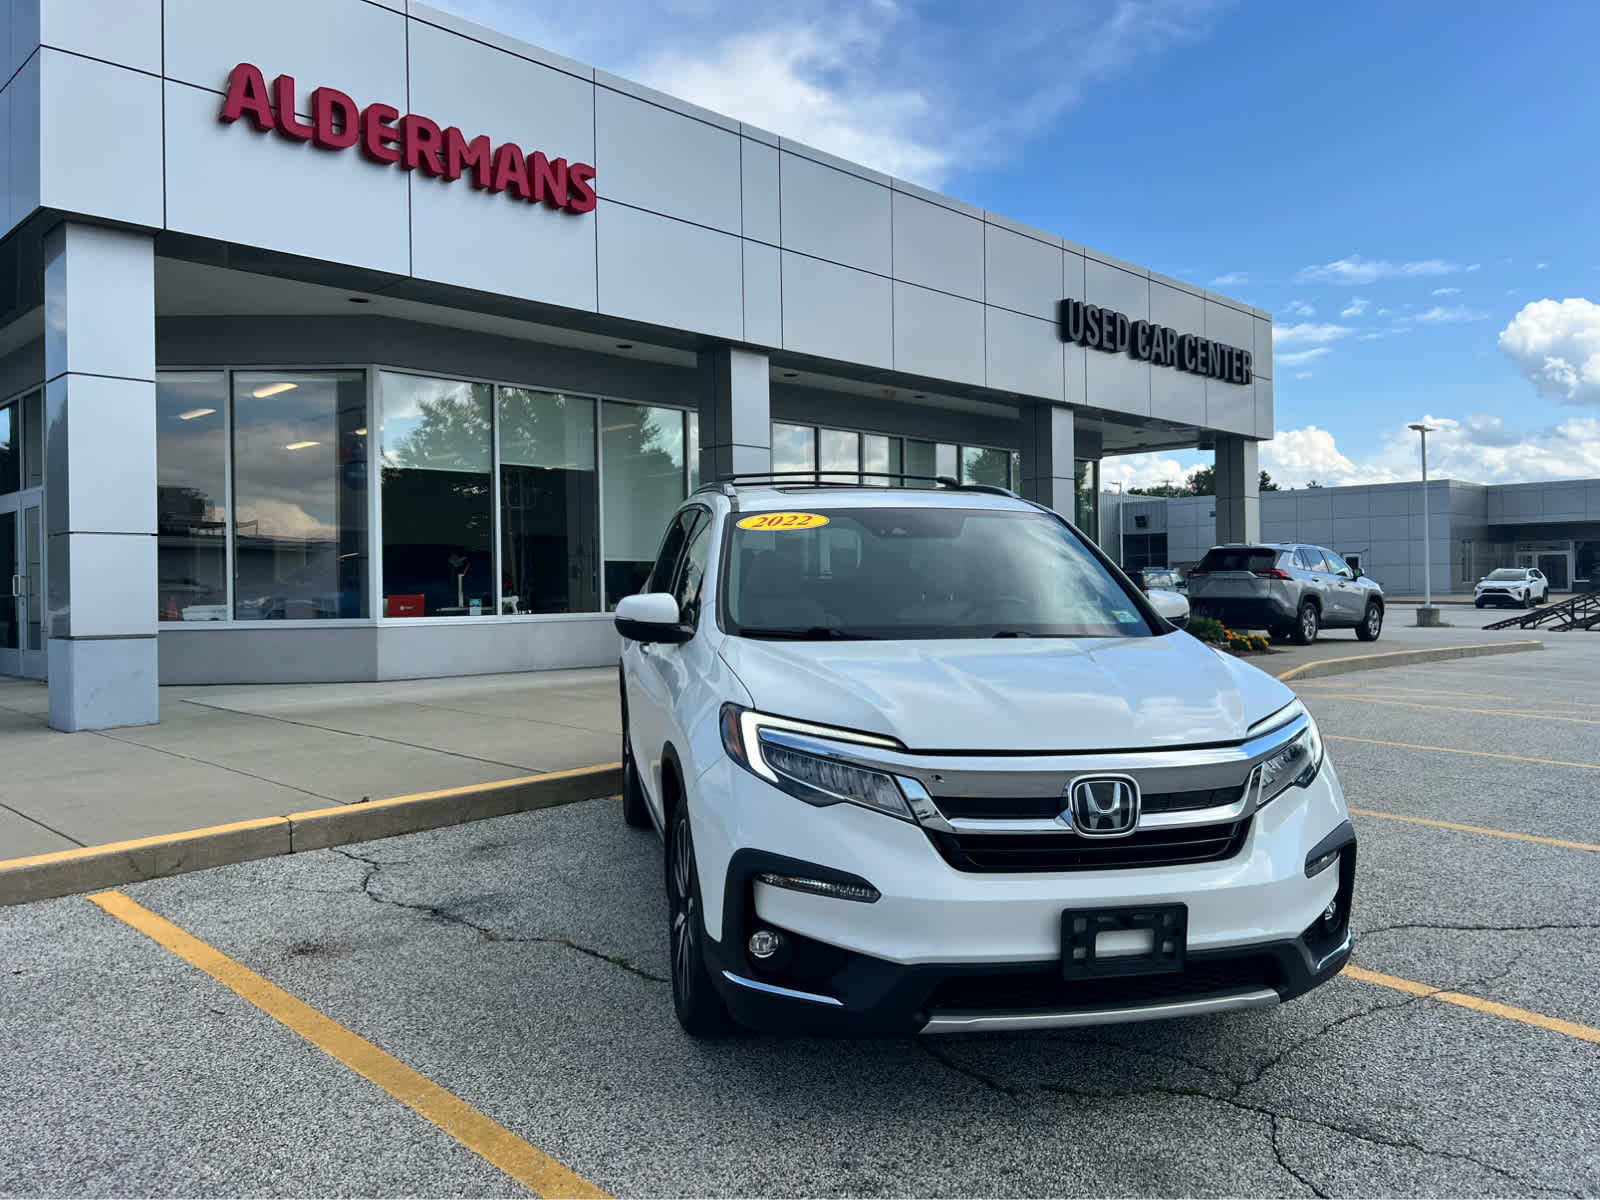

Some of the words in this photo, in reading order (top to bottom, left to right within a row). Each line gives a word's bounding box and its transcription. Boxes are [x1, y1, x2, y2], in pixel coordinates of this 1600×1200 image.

[219, 63, 597, 215] ALDERMANS
[1061, 298, 1130, 352] USED
[1131, 319, 1178, 366] CAR
[1179, 333, 1253, 384] CENTER
[751, 515, 813, 528] 2022
